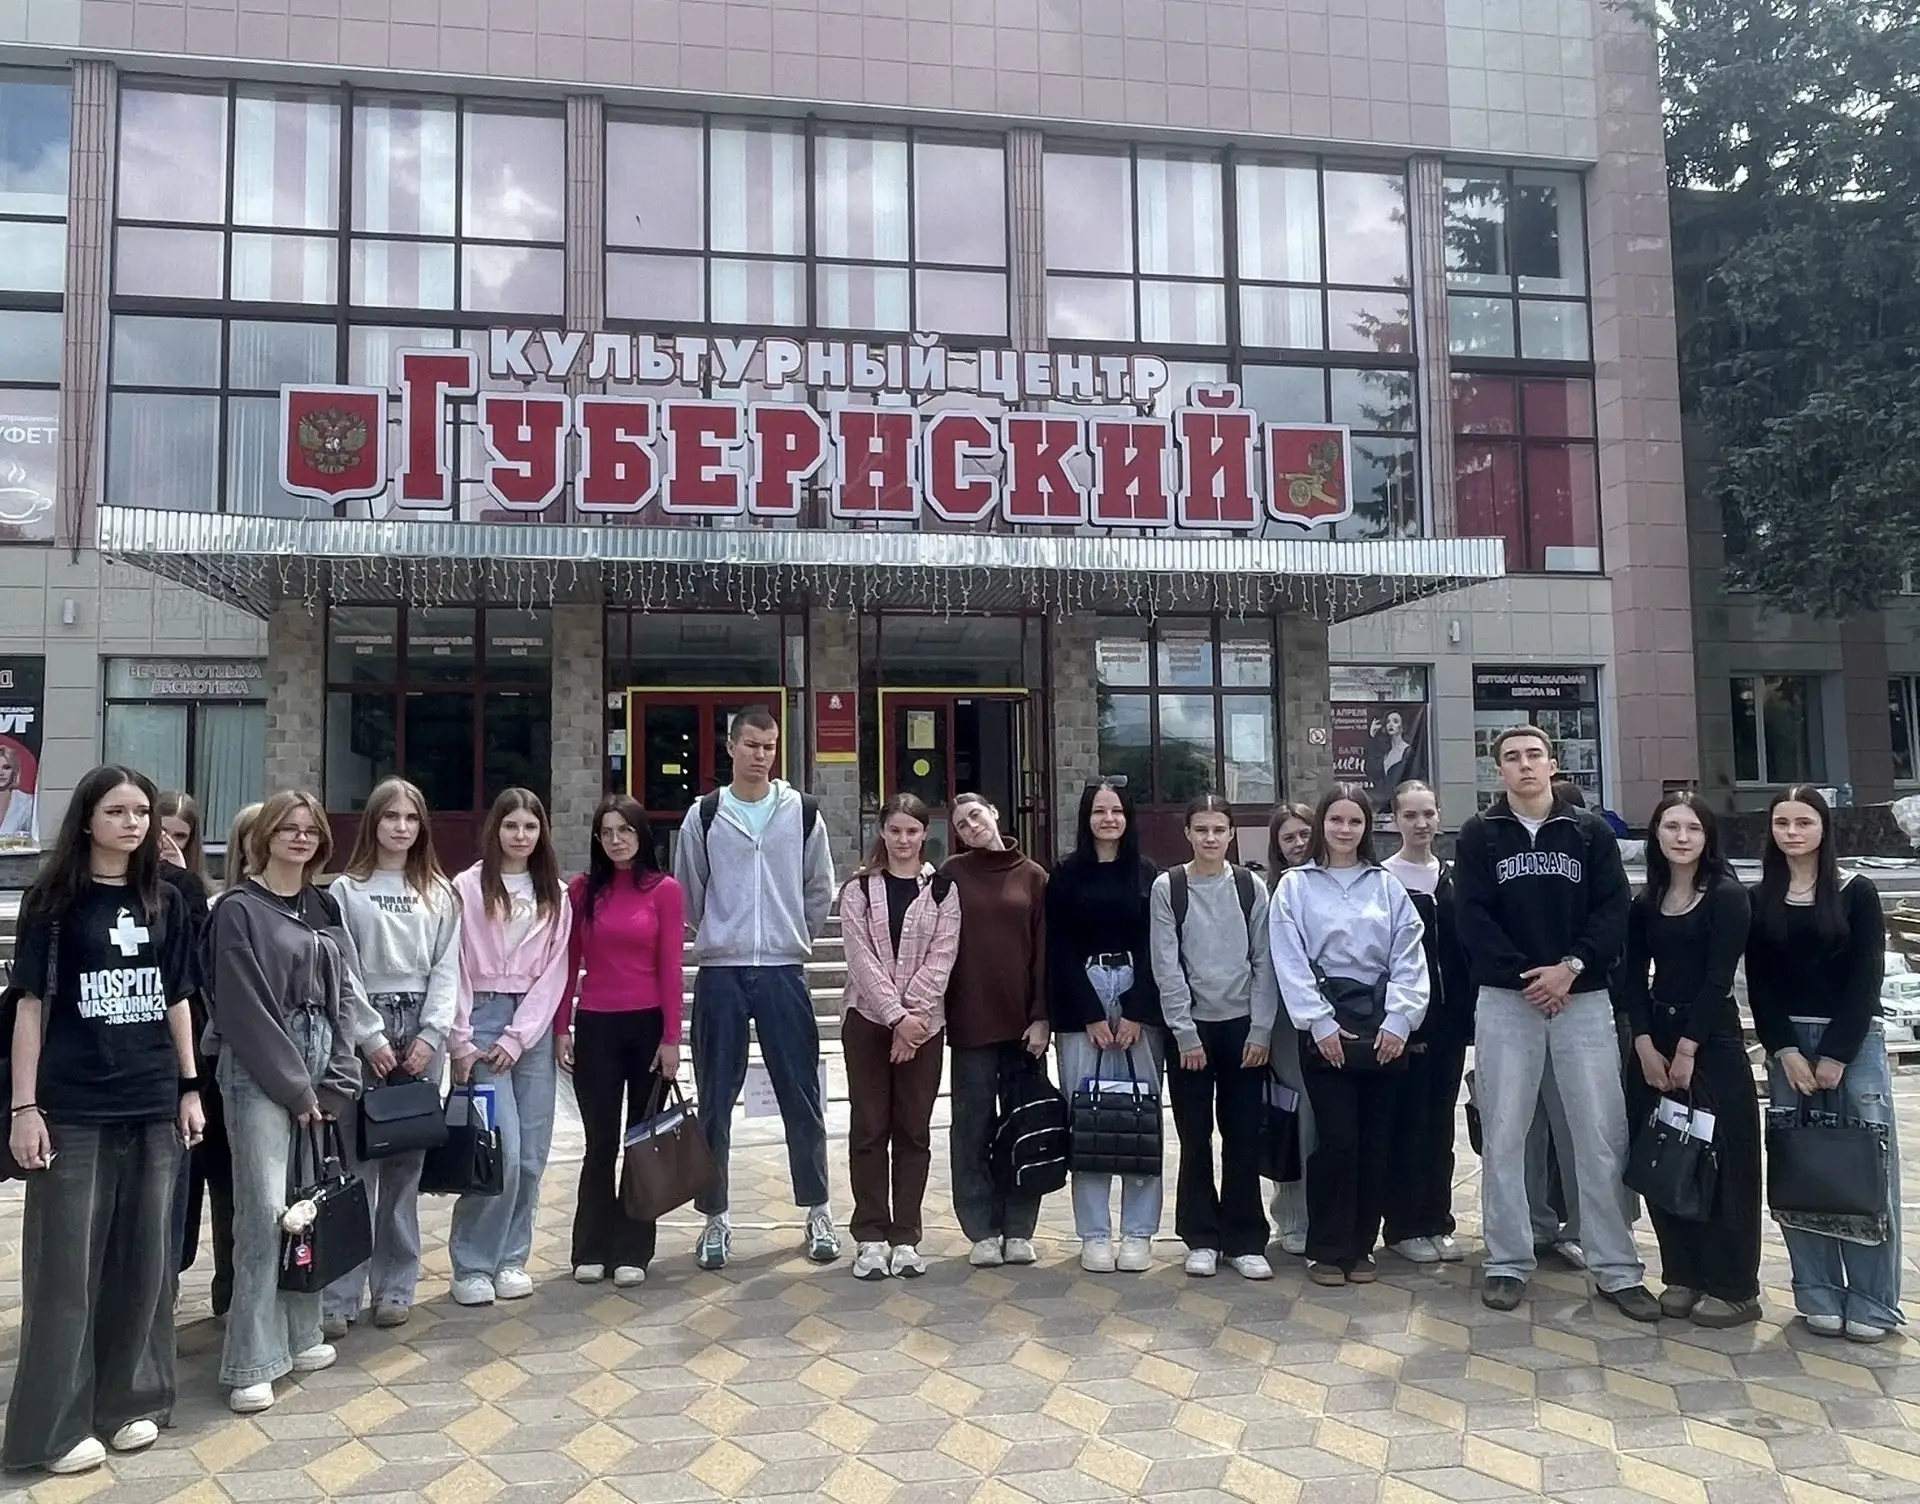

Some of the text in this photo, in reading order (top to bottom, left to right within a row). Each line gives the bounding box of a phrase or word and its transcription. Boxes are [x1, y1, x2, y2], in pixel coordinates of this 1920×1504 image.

[488, 327, 1168, 402] КУЛЬТУРНЫЙ ЦЕНТР
[0, 426, 59, 444] ФЕТ
[128, 664, 262, 679] ВЕЧЕРА ОТДЫХА
[151, 679, 249, 694] ДИСКОТЕКА
[1477, 674, 1519, 685] ДЕТСКАЯ
[1511, 687, 1546, 697] ШКОЛА
[1336, 708, 1368, 717] АПРЕЛЯ
[1332, 756, 1366, 773] мен
[1495, 851, 1582, 885] COLORADO
[383, 895, 419, 905] DRAMA
[379, 902, 413, 914] PLEASE
[79, 966, 164, 1001] HOSPITA
